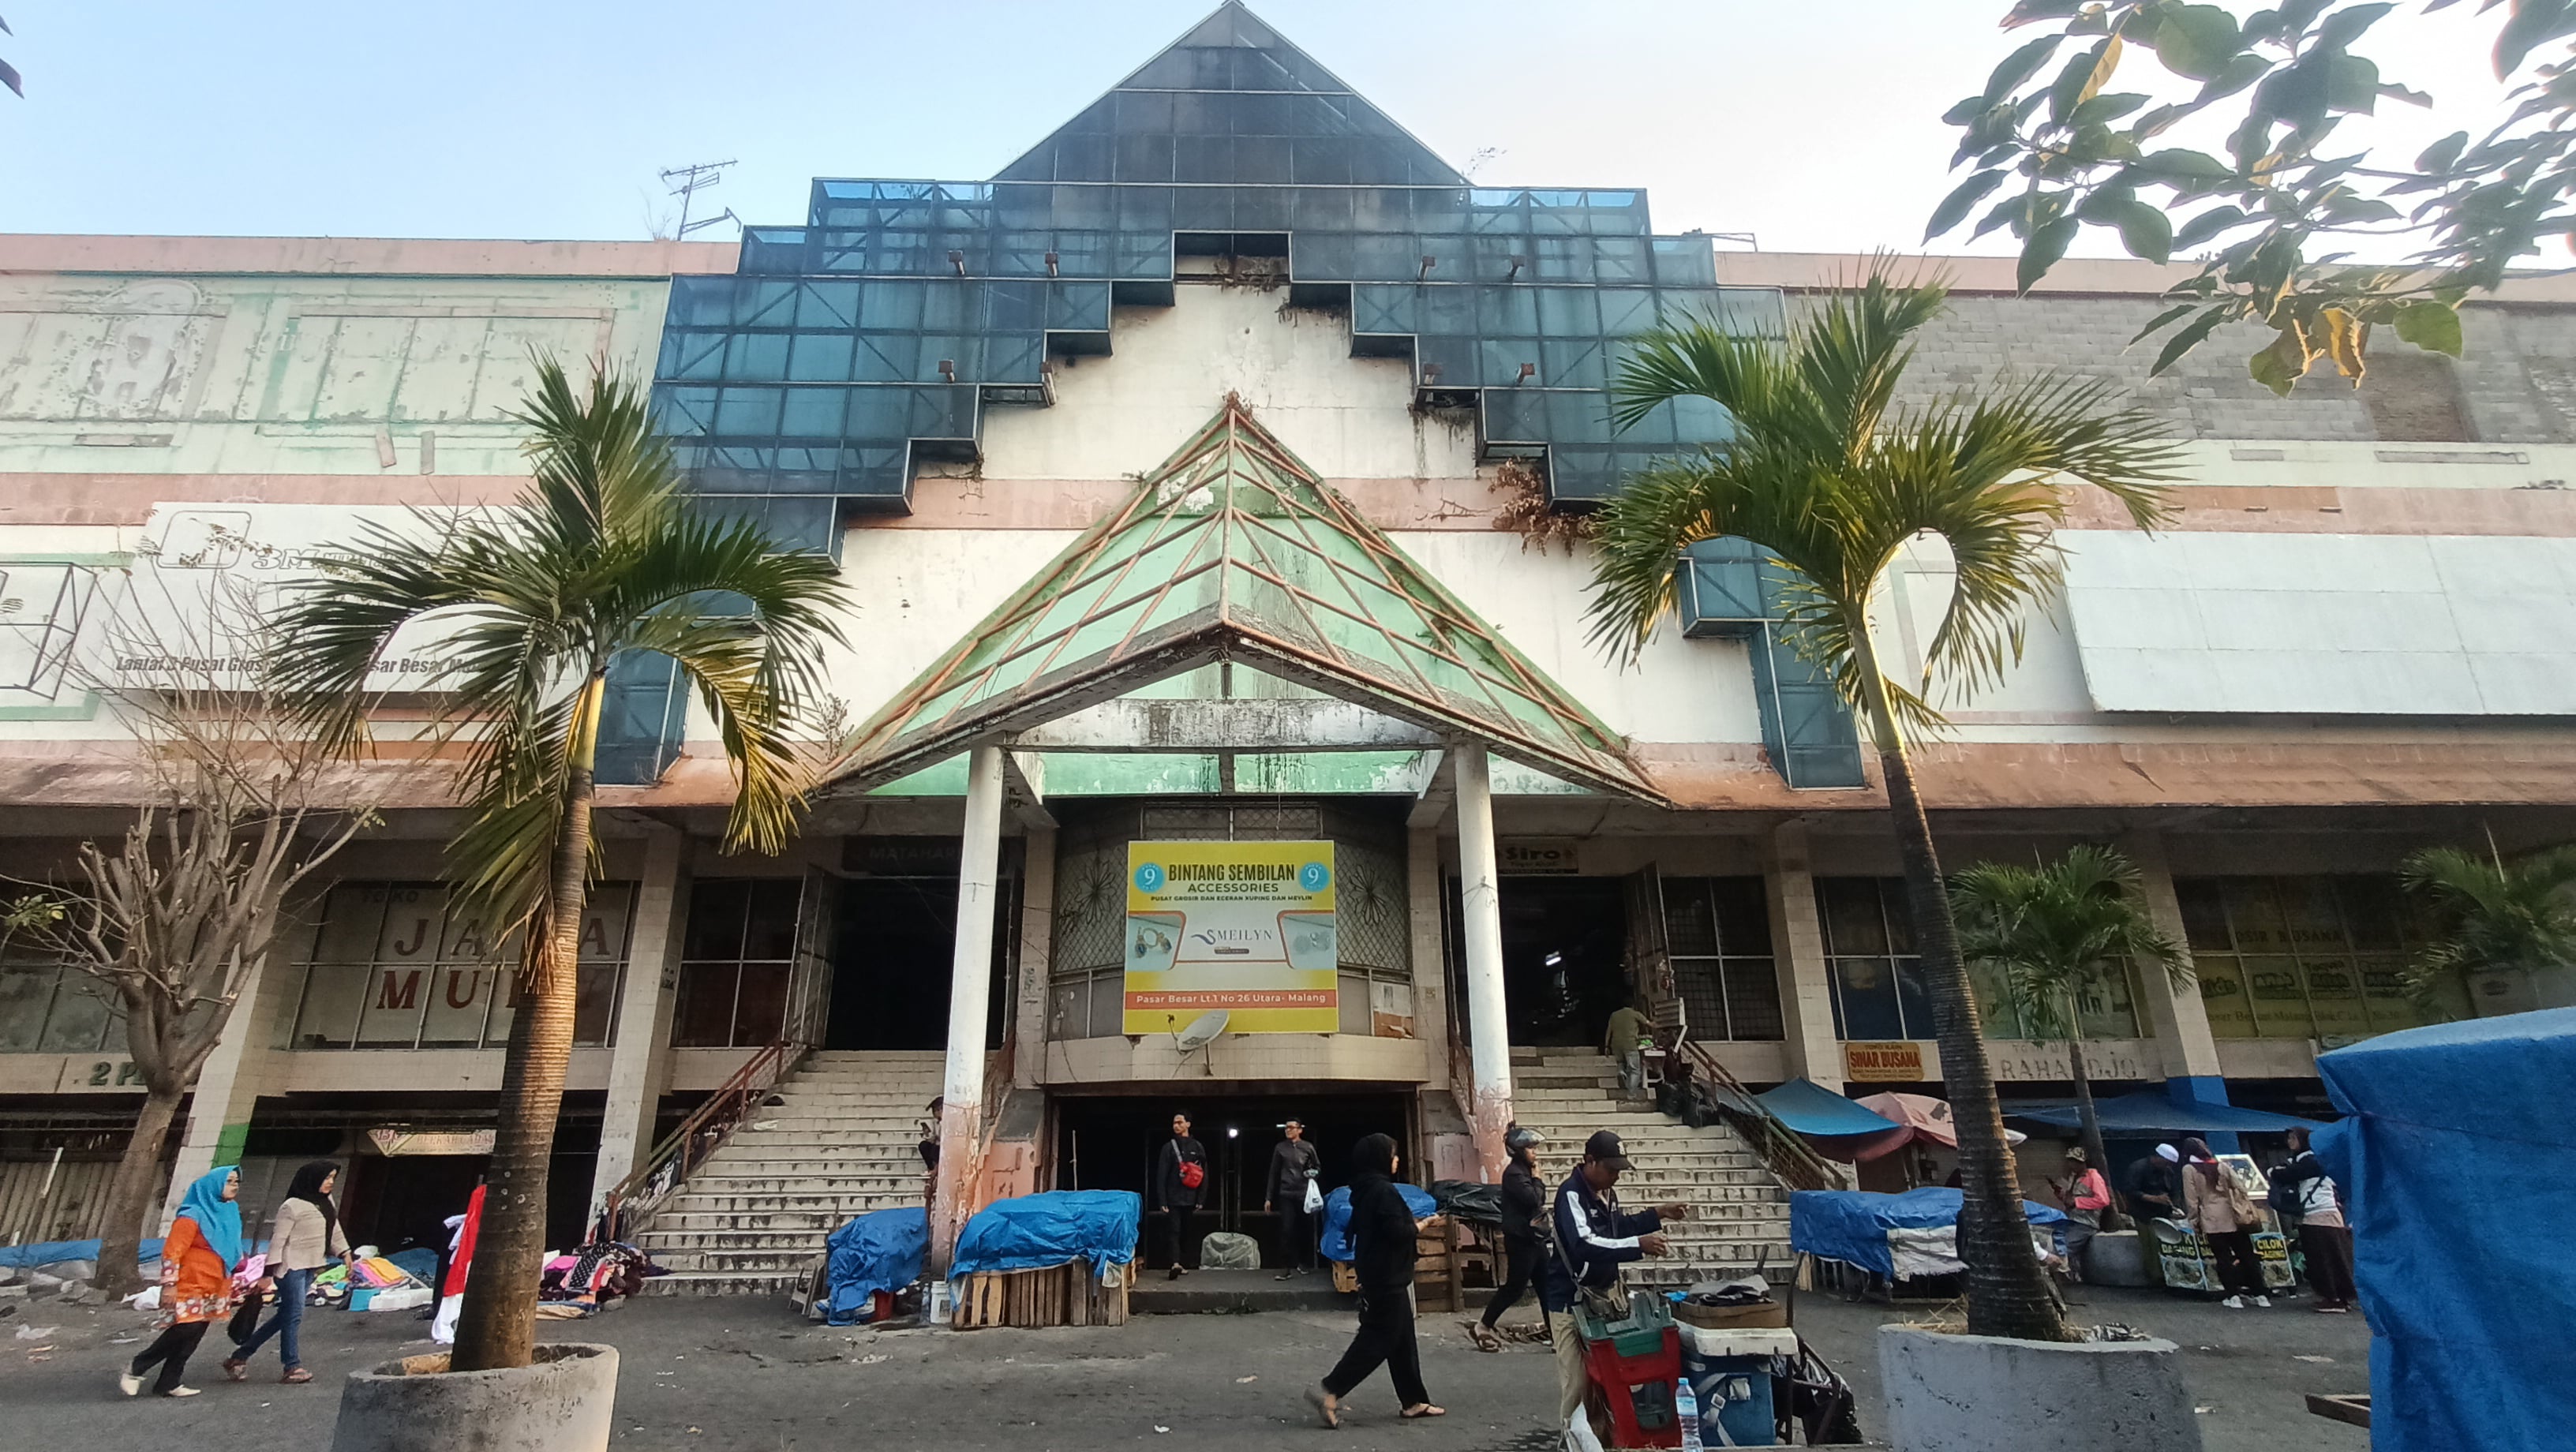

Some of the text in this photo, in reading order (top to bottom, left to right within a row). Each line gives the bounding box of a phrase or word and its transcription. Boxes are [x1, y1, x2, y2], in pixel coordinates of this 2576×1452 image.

[182, 656, 225, 672] Pusat
[1144, 868, 1156, 885] 9
[1168, 863, 1295, 881] BINTANG SEMBILAN
[1307, 867, 1320, 885] 9
[1187, 882, 1279, 893] ACCESSORIES
[395, 918, 611, 956] JAA
[1221, 994, 1234, 1003] No
[1237, 994, 1250, 1003] 26
[1288, 994, 1327, 1004] Malang
[1849, 1050, 1922, 1068] SINAR BUSANA
[89, 1061, 112, 1086] 2
[2001, 1058, 2136, 1079] RAHADJO
[2256, 1239, 2283, 1249] CILOK
